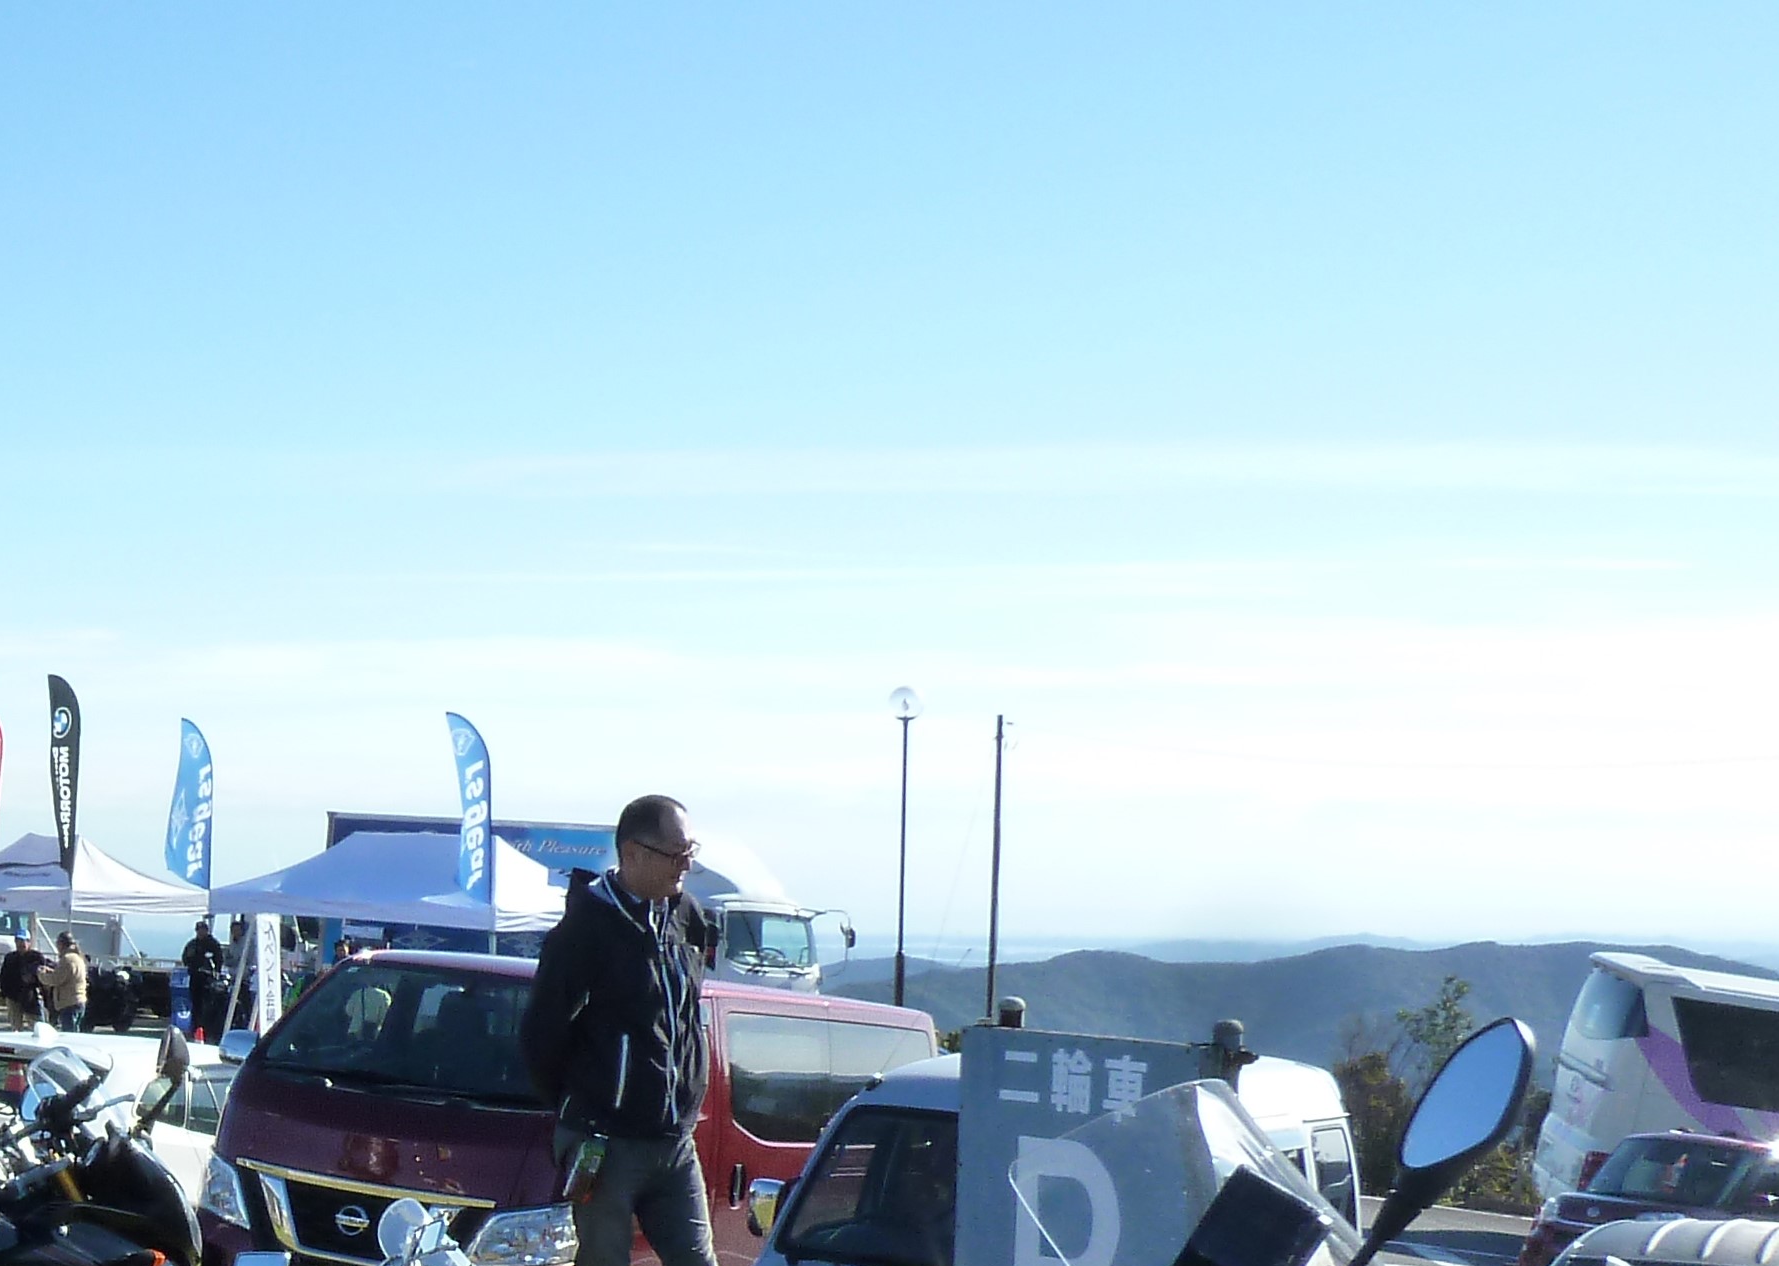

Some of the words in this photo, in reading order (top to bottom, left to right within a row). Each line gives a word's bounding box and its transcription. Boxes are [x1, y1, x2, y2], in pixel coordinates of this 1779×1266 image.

[538, 840, 608, 856] Pleasure
[999, 1047, 1149, 1120] 二輪車
